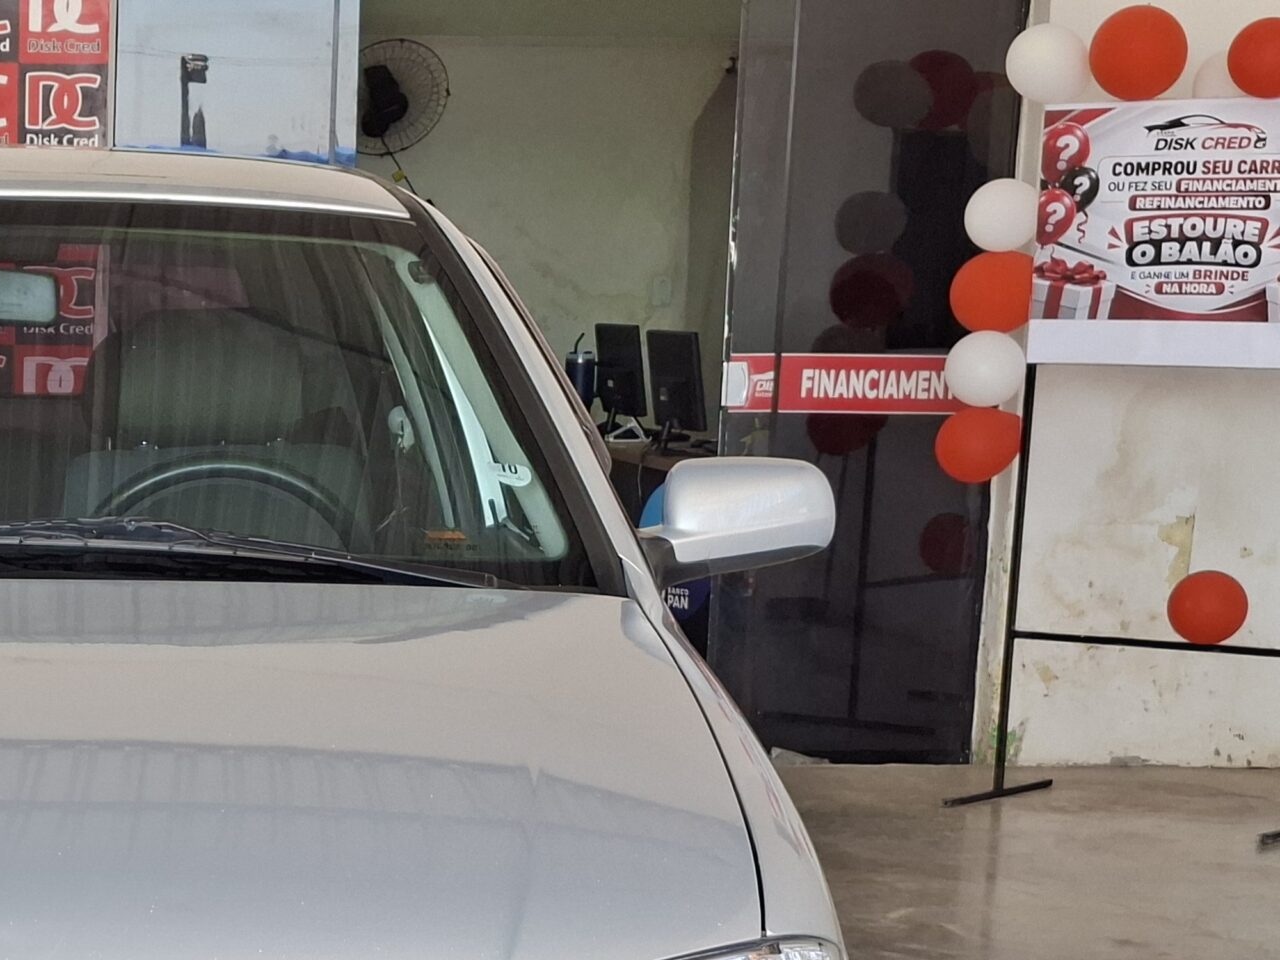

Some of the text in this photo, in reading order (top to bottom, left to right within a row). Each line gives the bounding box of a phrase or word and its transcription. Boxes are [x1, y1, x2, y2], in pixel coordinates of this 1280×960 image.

[27, 38, 101, 53] Disk Cred
[26, 134, 98, 147] Disk Cred
[1154, 136, 1252, 151] DISK CRED
[1112, 160, 1280, 176] COMPROU SEU CARR
[1108, 179, 1280, 192] OU FEZ SEU FINANCIAMENT
[1136, 196, 1265, 209] REFINANCIAMENTO
[1132, 217, 1262, 242] ESTOURE
[1132, 239, 1257, 266] O BALÃO
[1138, 271, 1171, 280] GANHE
[1174, 271, 1189, 280] UM
[1192, 269, 1249, 281] BRINDE
[1162, 283, 1217, 294] NA HORA
[60, 321, 94, 335] Cred
[800, 368, 948, 400] FINANCIAMEN
[667, 595, 689, 610] PAN
